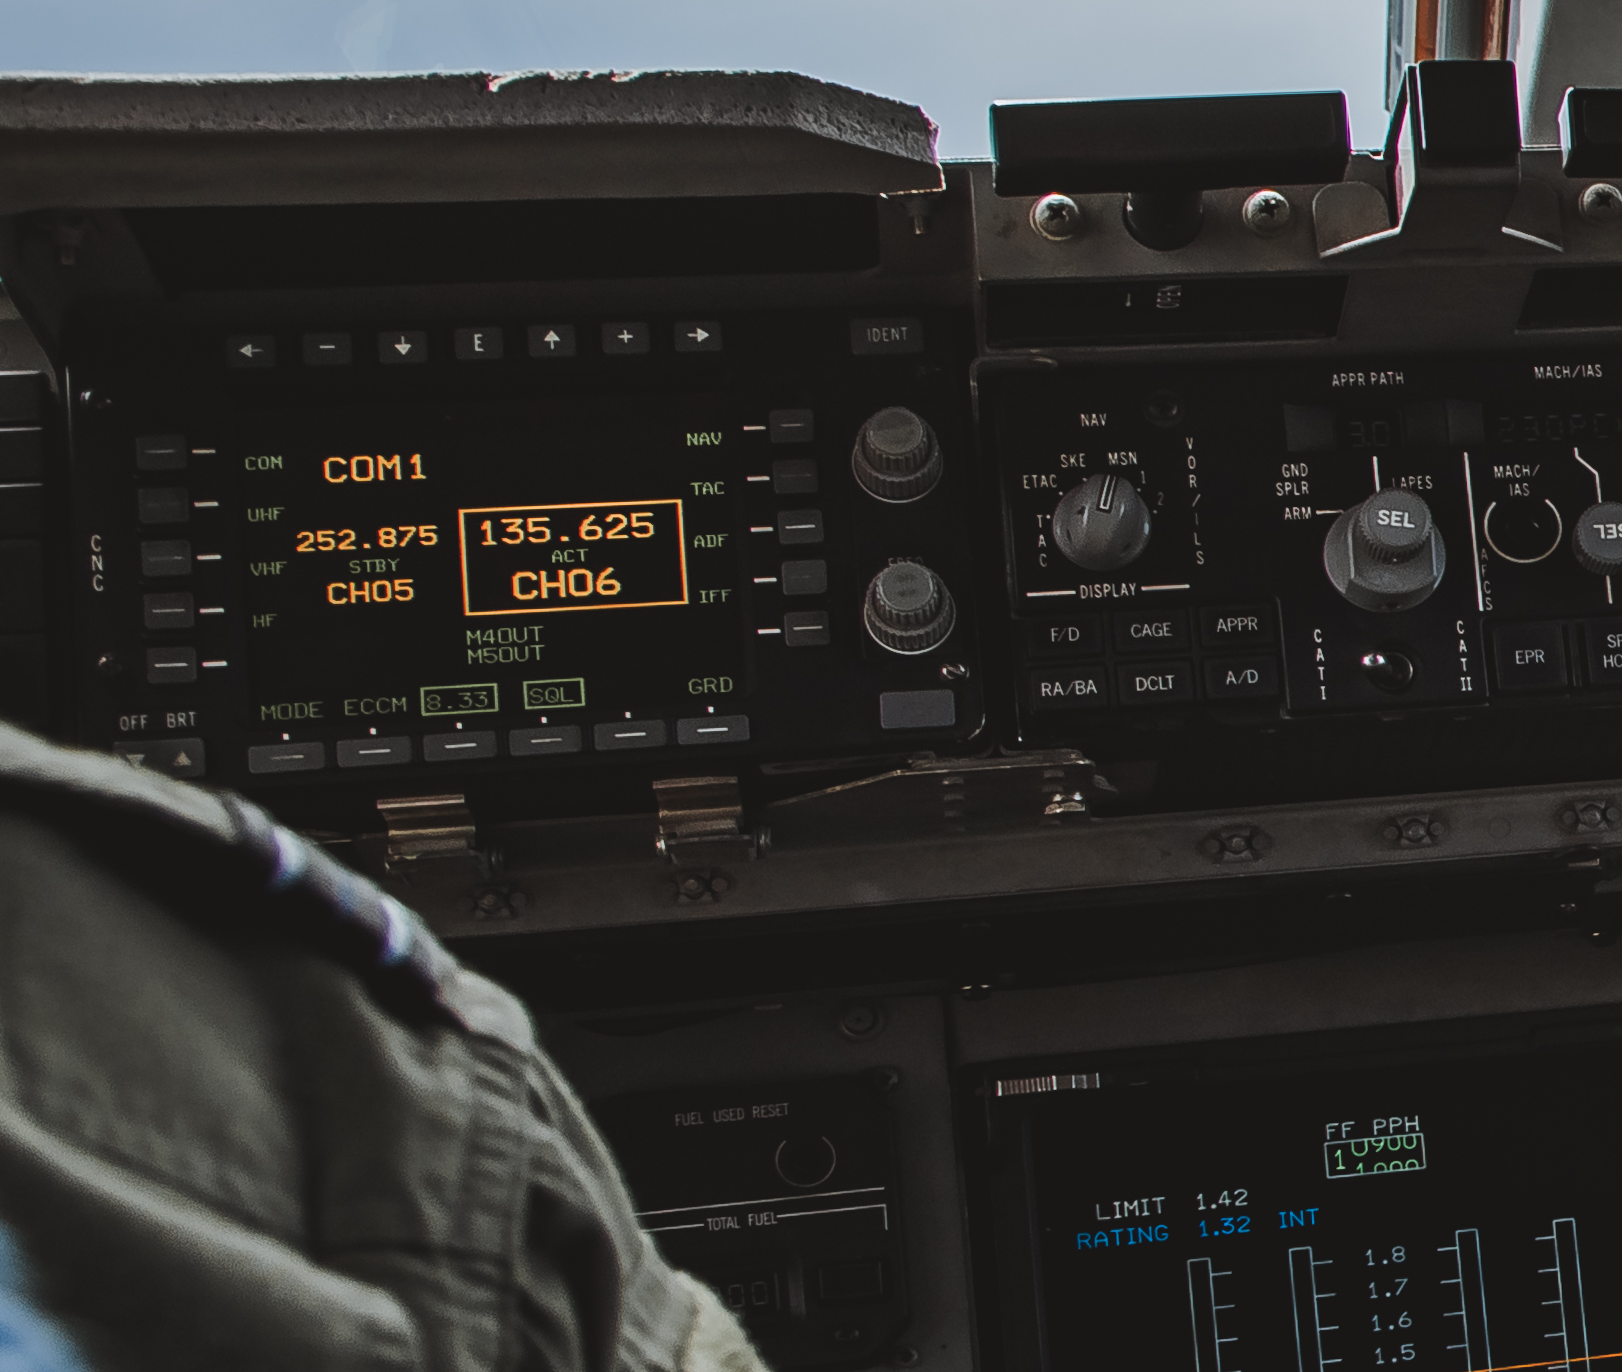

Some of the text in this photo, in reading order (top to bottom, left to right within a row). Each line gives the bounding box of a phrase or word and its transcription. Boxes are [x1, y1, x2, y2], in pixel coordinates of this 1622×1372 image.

[866, 325, 909, 344] IDENT
[1332, 371, 1405, 387] APPR PATH
[1080, 413, 1107, 428] NAV
[686, 431, 722, 448] NAV
[245, 455, 284, 472] COM
[1060, 453, 1086, 468] SKE
[690, 480, 726, 497] TAC
[248, 506, 284, 523] UHF
[1284, 507, 1312, 521] ARM
[1377, 509, 1416, 528] SEL
[297, 523, 438, 553] 252.875
[479, 511, 655, 547] 135.625
[694, 533, 729, 549] ADF
[550, 547, 589, 564] ACT
[250, 561, 288, 577] VHF
[348, 558, 401, 575] STBY
[698, 587, 732, 604] IFF
[1080, 583, 1137, 599] DISPLAY
[252, 612, 277, 628] HF
[1216, 617, 1258, 632] APPR
[1130, 622, 1172, 638] CAGE
[688, 676, 734, 695] GRD
[1136, 675, 1175, 691] DCLT
[426, 689, 491, 712] 8.33
[529, 683, 576, 706] SQL
[260, 700, 323, 720] MODE
[344, 695, 407, 716] ECCM
[674, 1103, 790, 1127] FUEL USED RESET
[1325, 1115, 1421, 1141] FF PPH
[1095, 1188, 1249, 1221] LIMIT 1.42
[707, 1210, 778, 1232] TOTAL FUEL
[1075, 1208, 1320, 1250] RATING 1.32 INT
[1365, 1246, 1407, 1267] 1.8
[1368, 1280, 1409, 1300] 1.7
[1370, 1311, 1413, 1332] 1.6
[1373, 1344, 1417, 1365] 1.5
